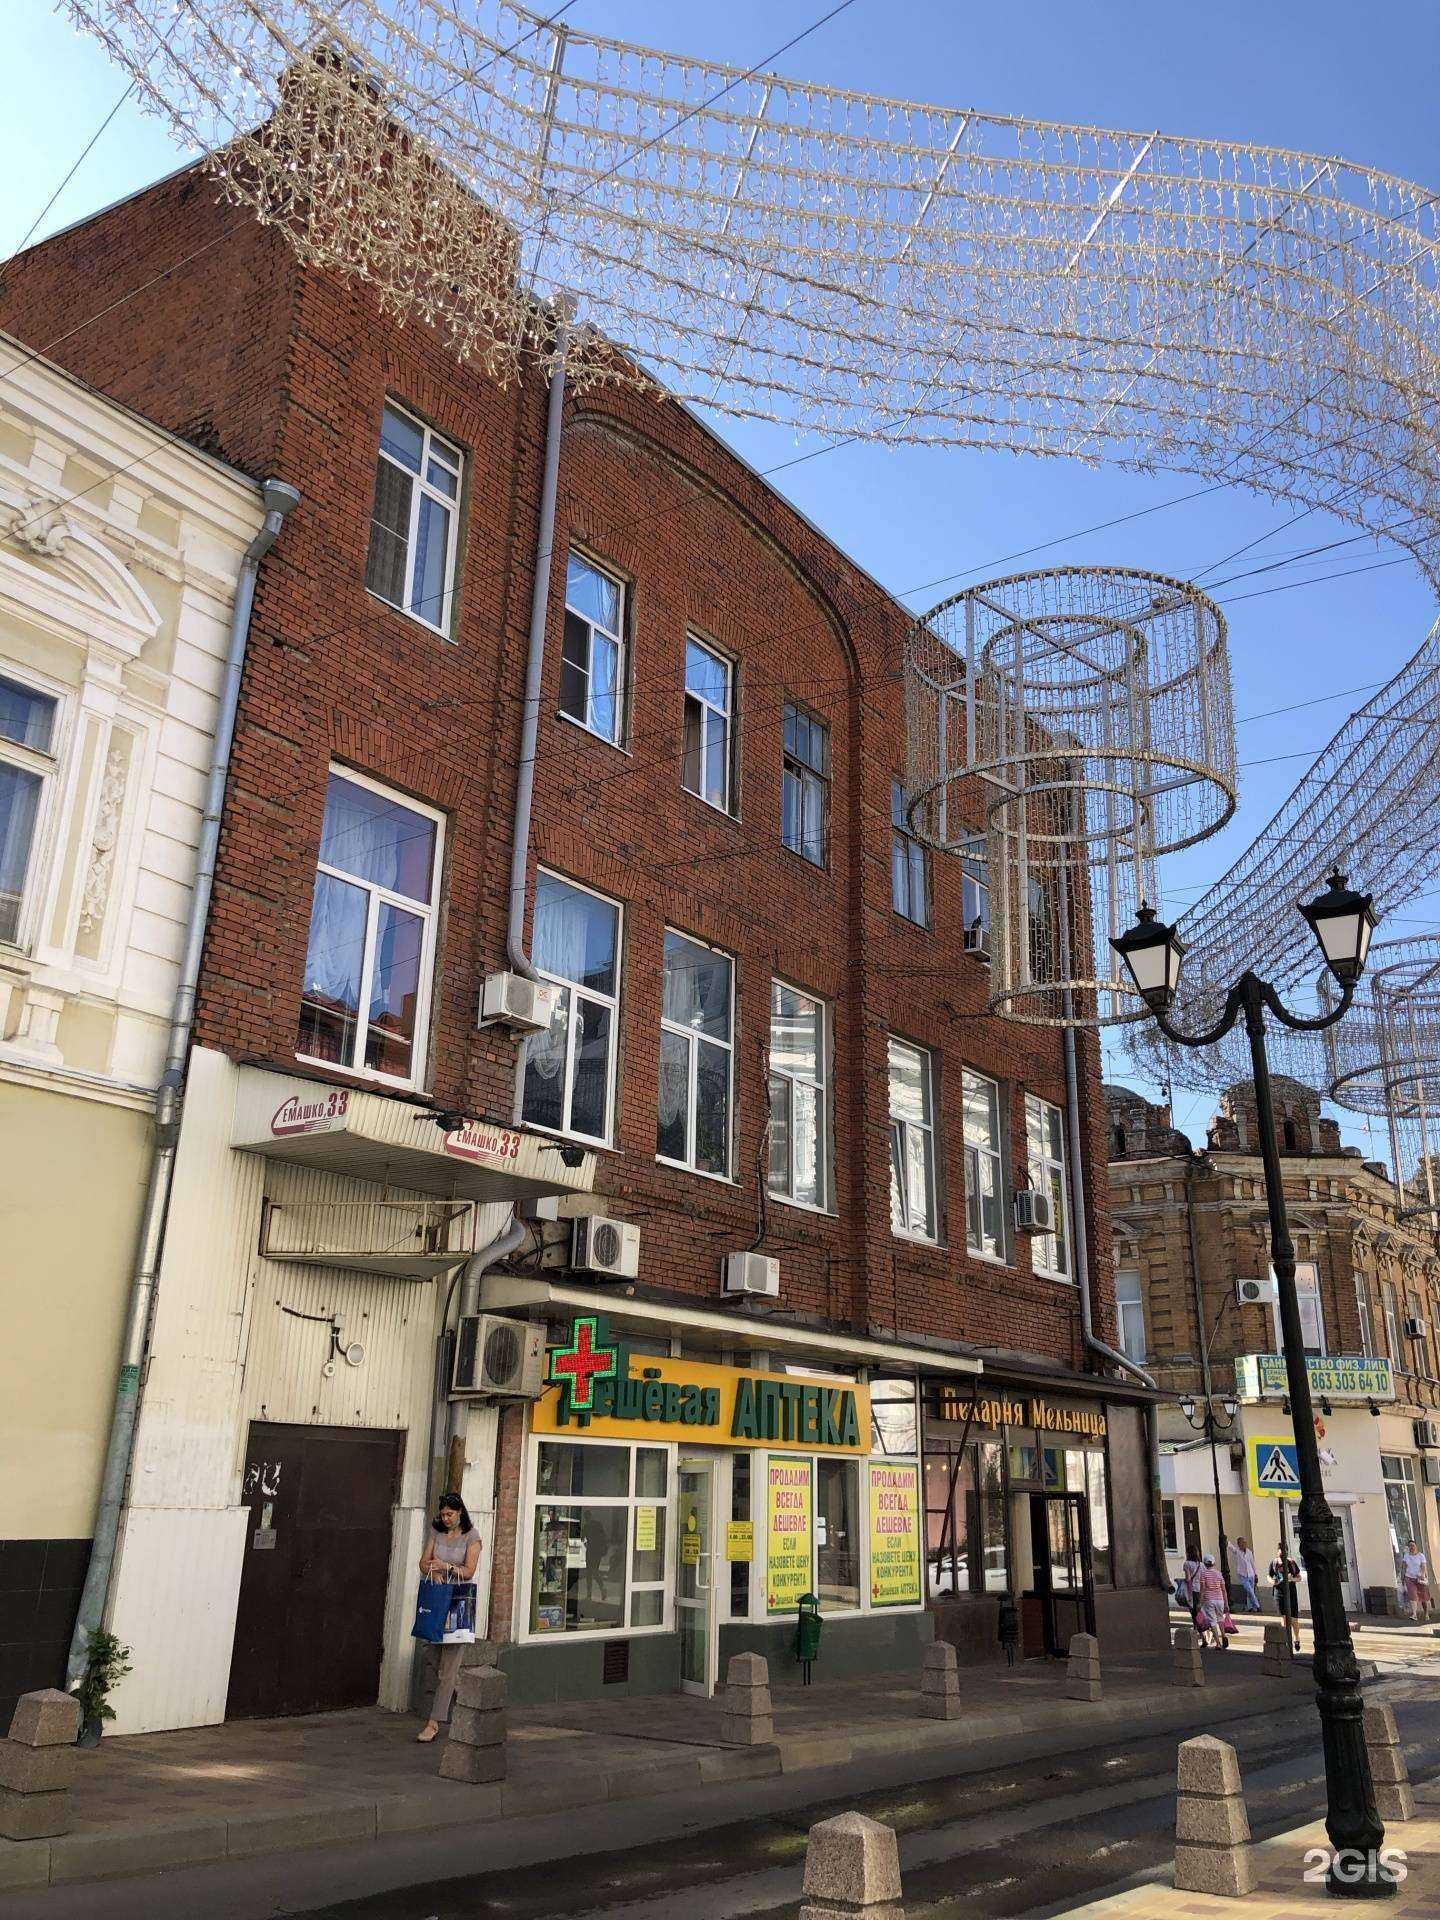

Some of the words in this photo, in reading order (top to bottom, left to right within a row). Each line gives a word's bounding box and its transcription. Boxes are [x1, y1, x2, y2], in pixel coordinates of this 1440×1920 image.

[1312, 1372, 1332, 1390] 863
[1335, 1373, 1356, 1391] 303
[1359, 1373, 1373, 1391] 64
[1376, 1374, 1388, 1391] 10
[731, 1377, 861, 1446] АПТЕКА
[1032, 1397, 1107, 1438] Мельница
[769, 1468, 810, 1487] ПРОДАДИМ
[871, 1470, 915, 1488] ПРОДАДИМ
[776, 1491, 804, 1509] ВСЕГДА
[878, 1493, 909, 1511] ВСЕГДА
[773, 1515, 807, 1532] ДЕШЕВЛЕ
[876, 1516, 912, 1533] ДЕШЕВЛЕ
[783, 1538, 797, 1551] ЕСЛИ
[887, 1536, 902, 1549] ЕСЛИ
[773, 1573, 807, 1587] КОНКУРЕНТА
[877, 1566, 913, 1578] КОНКУРЕНТА
